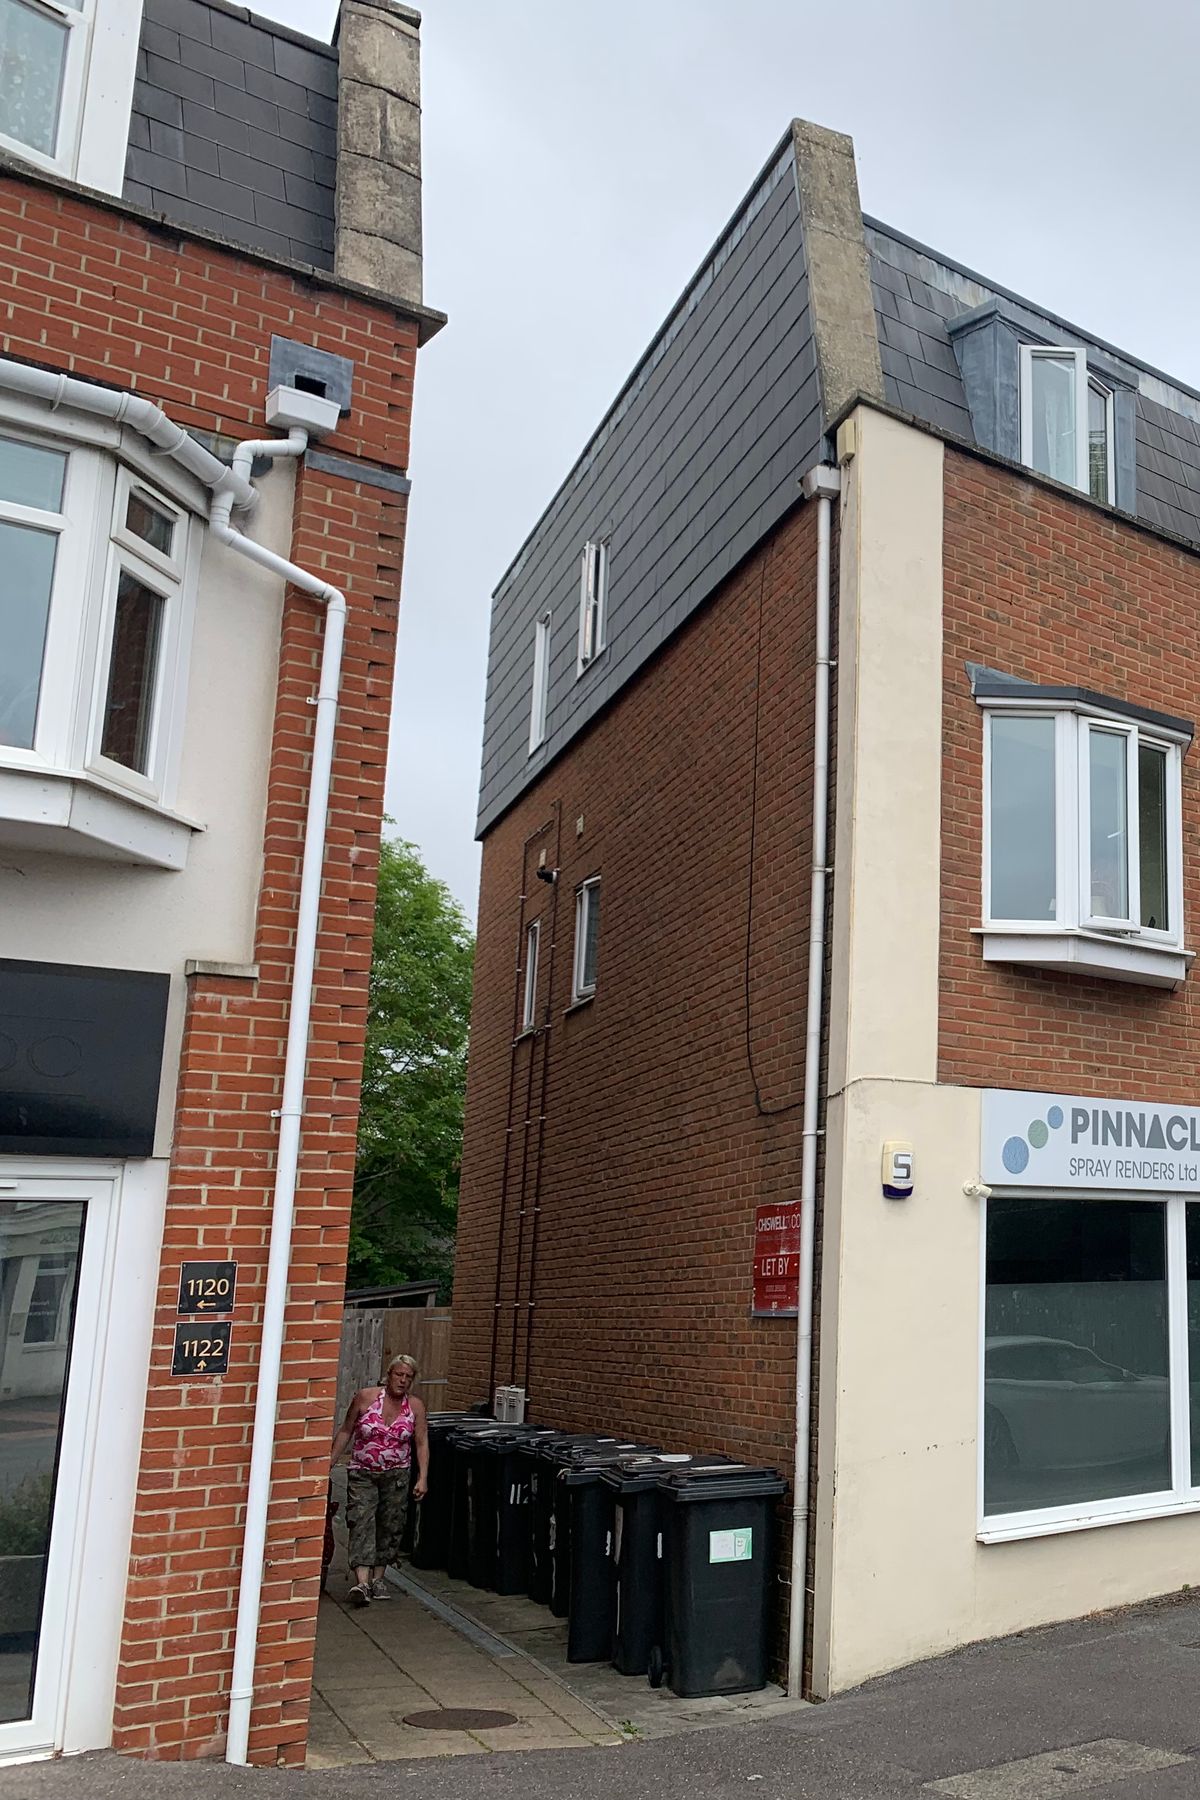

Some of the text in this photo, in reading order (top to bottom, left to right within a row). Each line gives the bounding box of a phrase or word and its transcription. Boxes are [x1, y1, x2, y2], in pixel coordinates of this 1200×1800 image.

[1069, 1157, 1198, 1182] SPRAY RENDERS Ltd
[761, 1257, 790, 1277] LET BY
[187, 1278, 230, 1296] 1120
[182, 1339, 224, 1358] 1122
